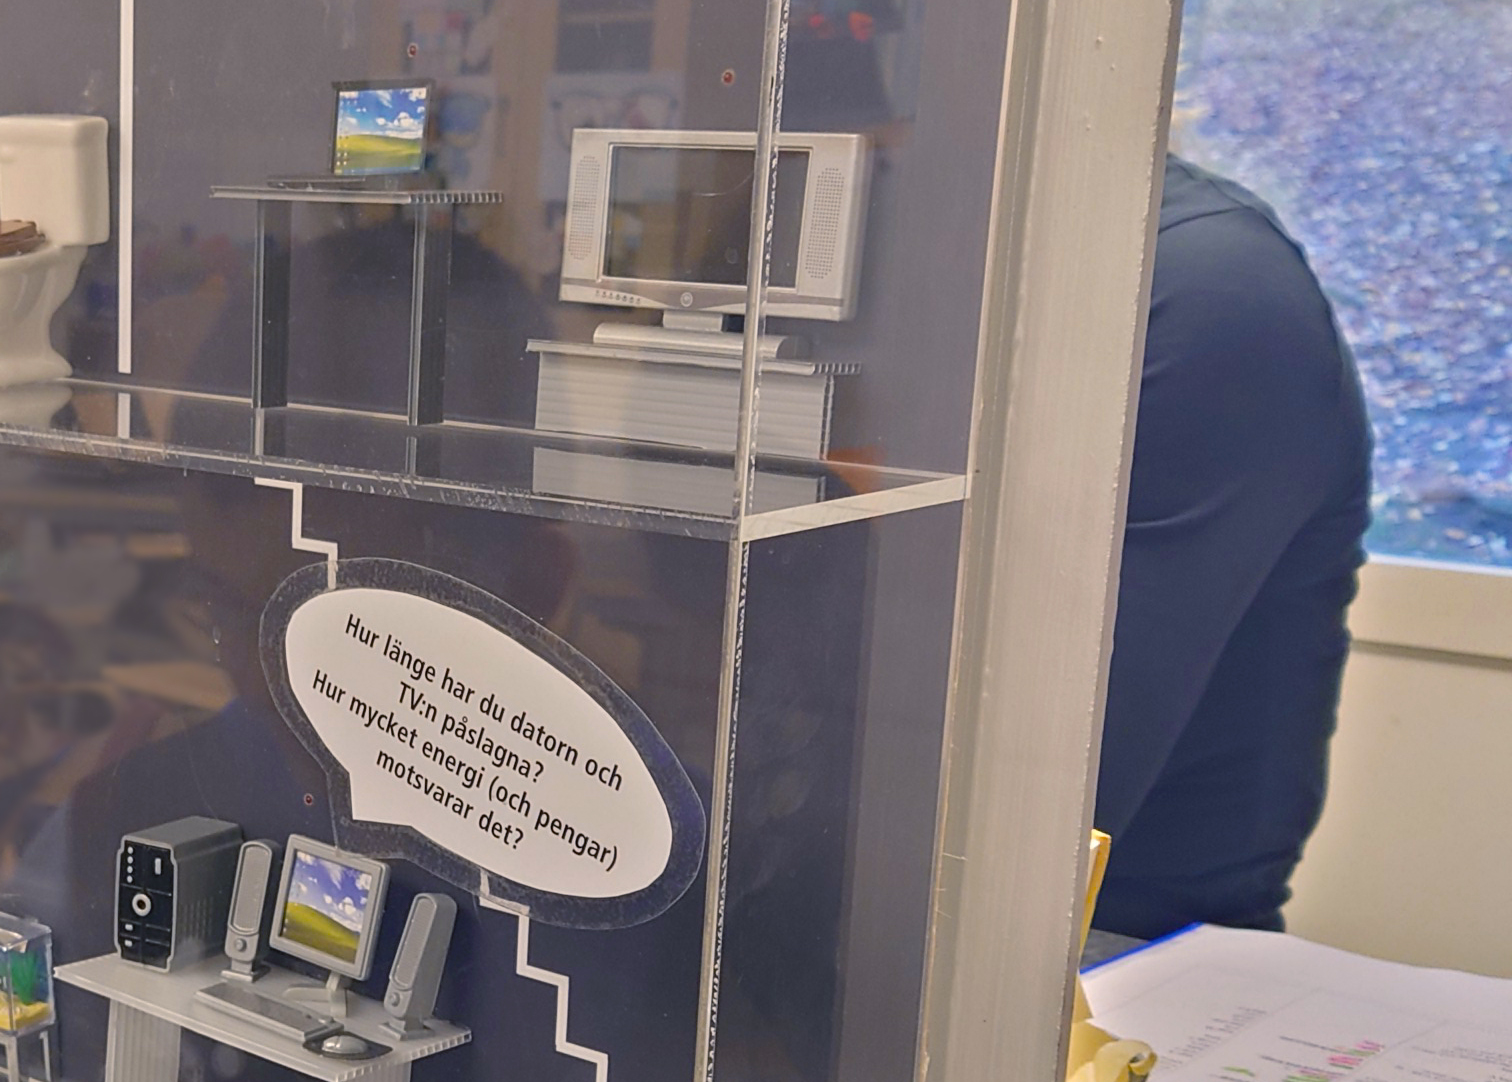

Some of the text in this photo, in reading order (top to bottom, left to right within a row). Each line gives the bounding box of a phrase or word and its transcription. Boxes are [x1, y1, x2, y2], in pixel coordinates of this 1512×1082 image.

[312, 669, 619, 873] Hur mycket energi (och pengar)
[345, 613, 624, 791] Hur länge har du datorn och
[397, 681, 545, 784] TV:n påslagna?
[376, 749, 525, 850] motsvarar det?
